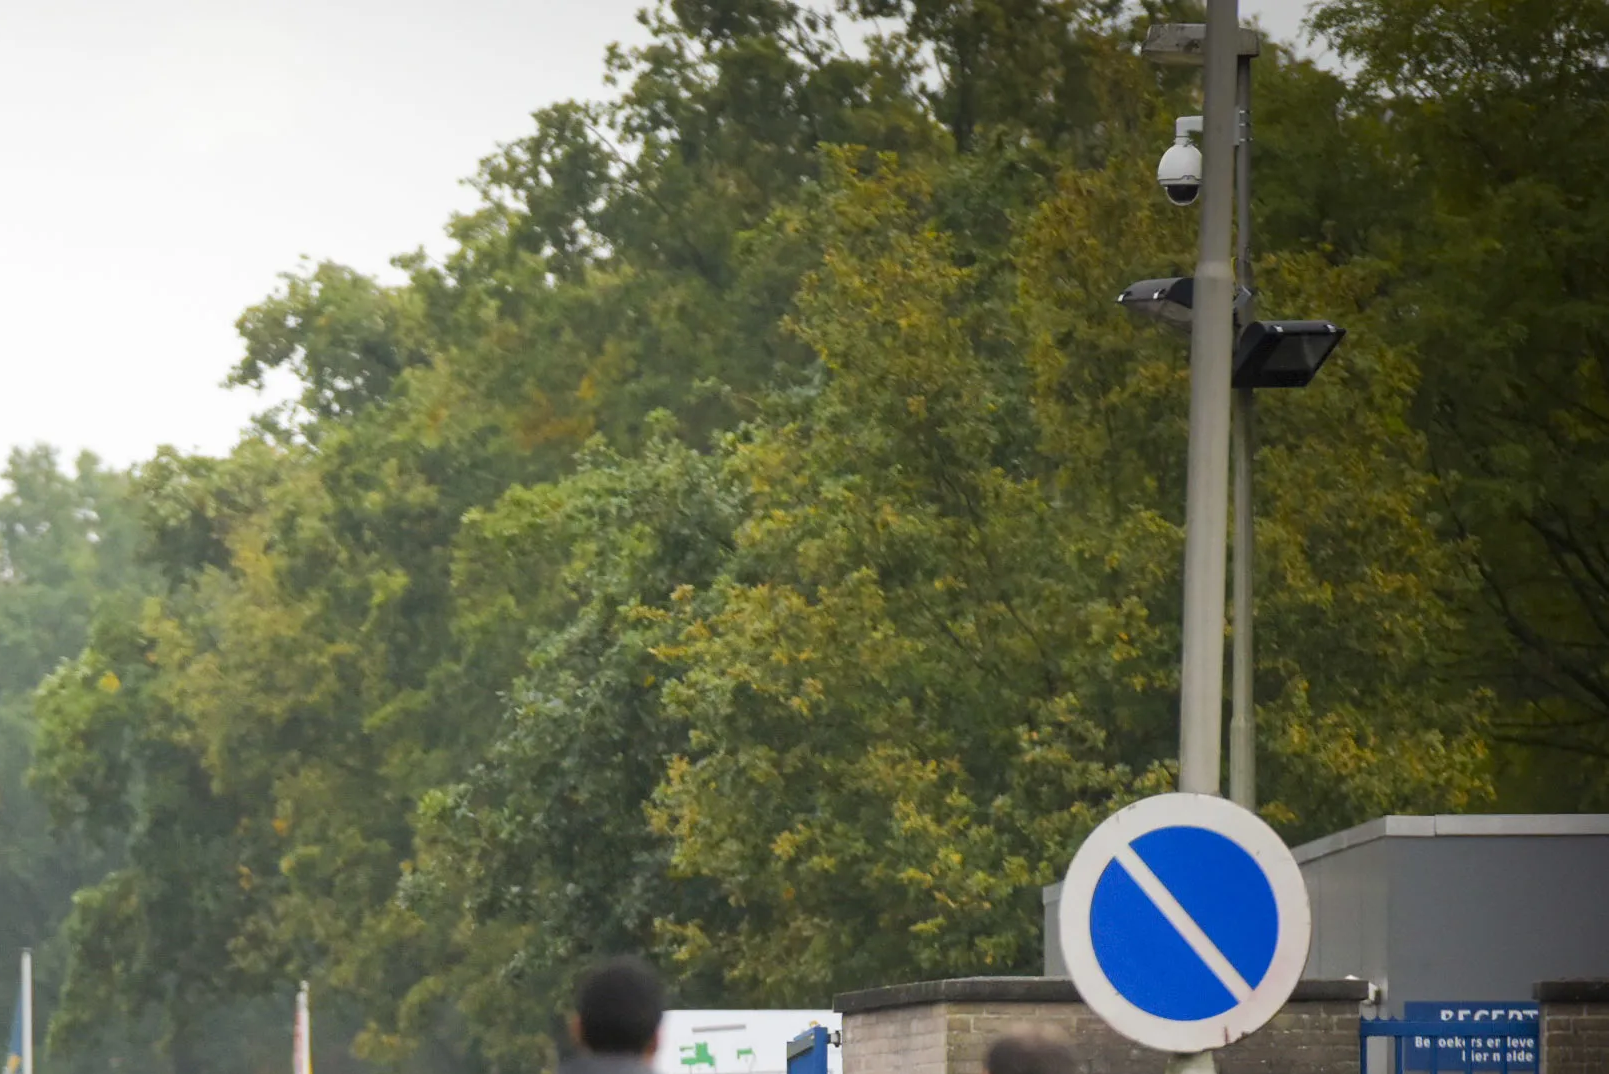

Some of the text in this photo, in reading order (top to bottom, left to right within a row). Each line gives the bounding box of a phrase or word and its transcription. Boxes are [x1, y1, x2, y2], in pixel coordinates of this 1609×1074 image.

[1439, 1009, 1538, 1021] RECEPT
[1415, 1036, 1483, 1048] Beoekrs
[1506, 1035, 1535, 1048] leve
